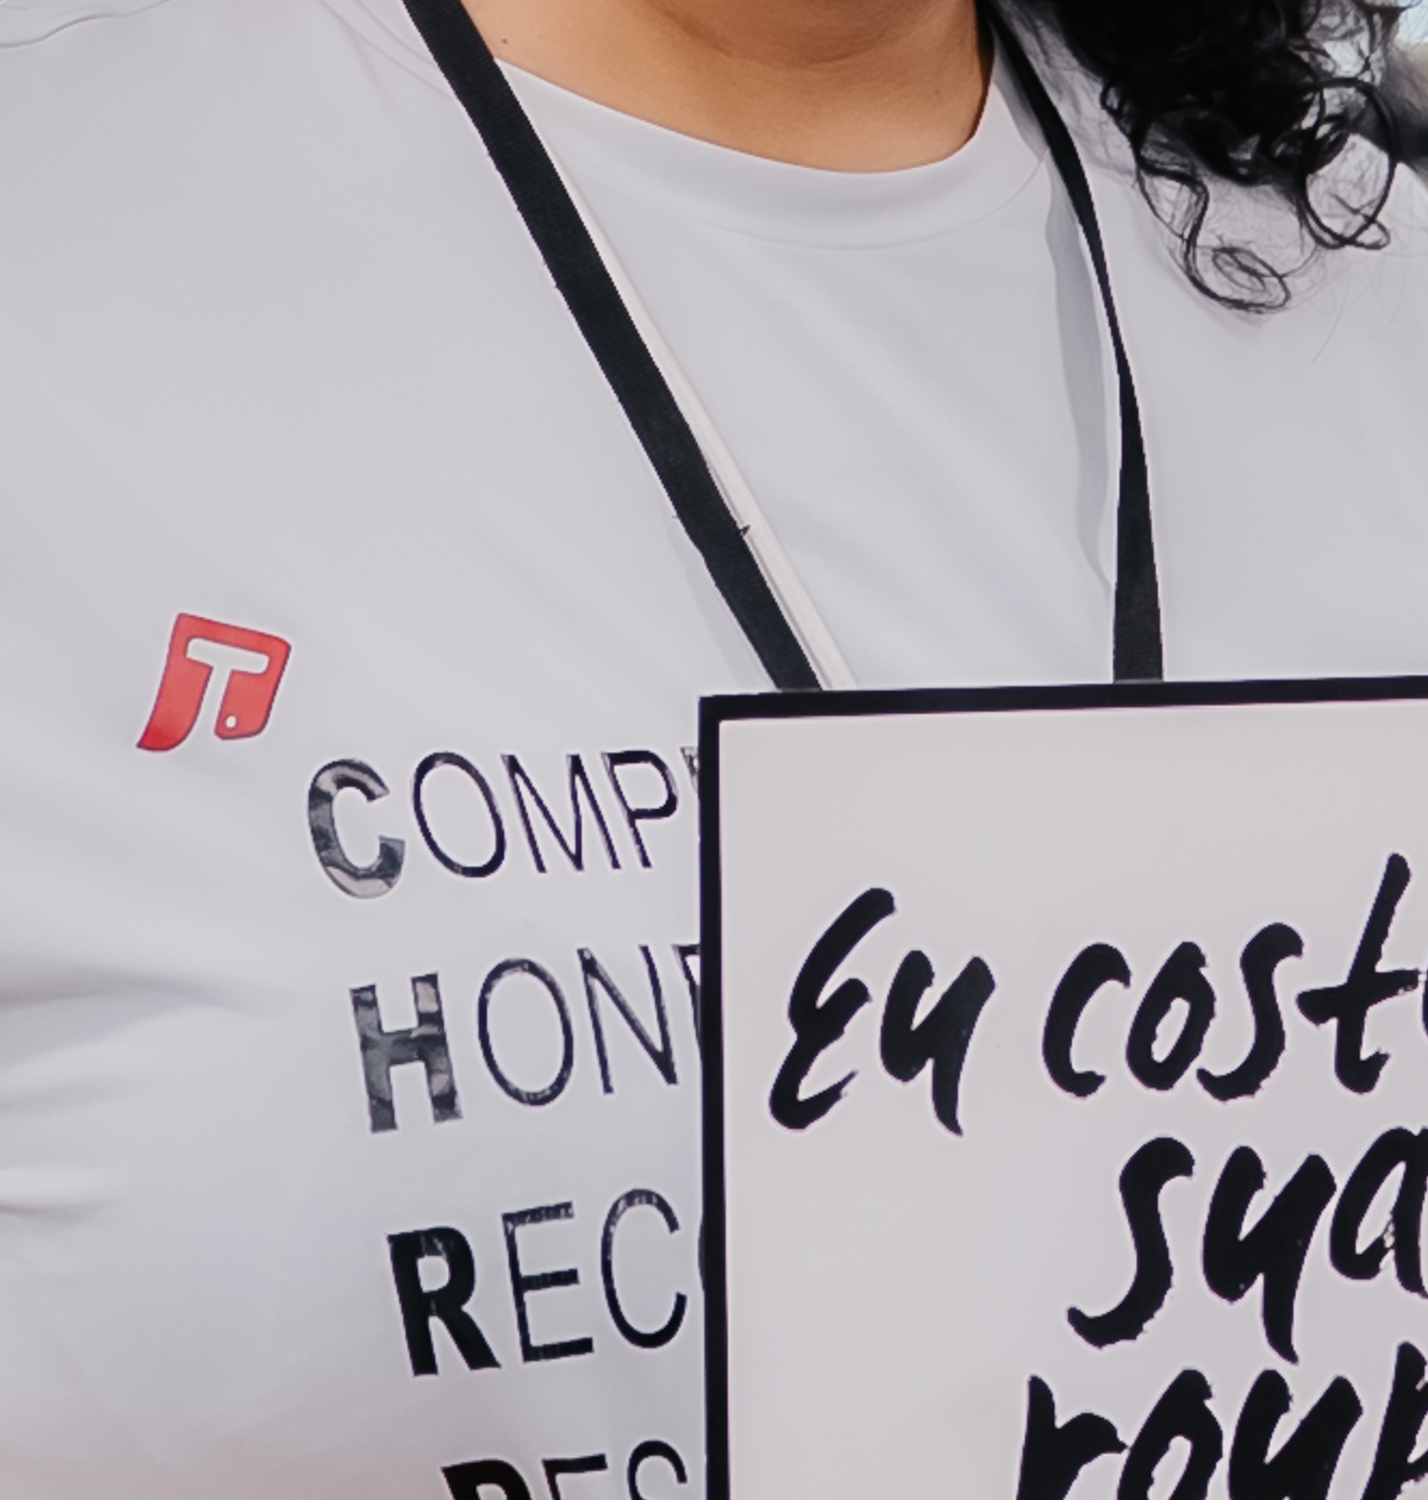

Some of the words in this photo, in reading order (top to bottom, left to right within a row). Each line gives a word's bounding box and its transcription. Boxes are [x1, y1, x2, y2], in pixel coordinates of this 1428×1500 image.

[307, 746, 699, 898] COMP
[768, 887, 996, 1136] Eu
[386, 1188, 702, 1377] REC
